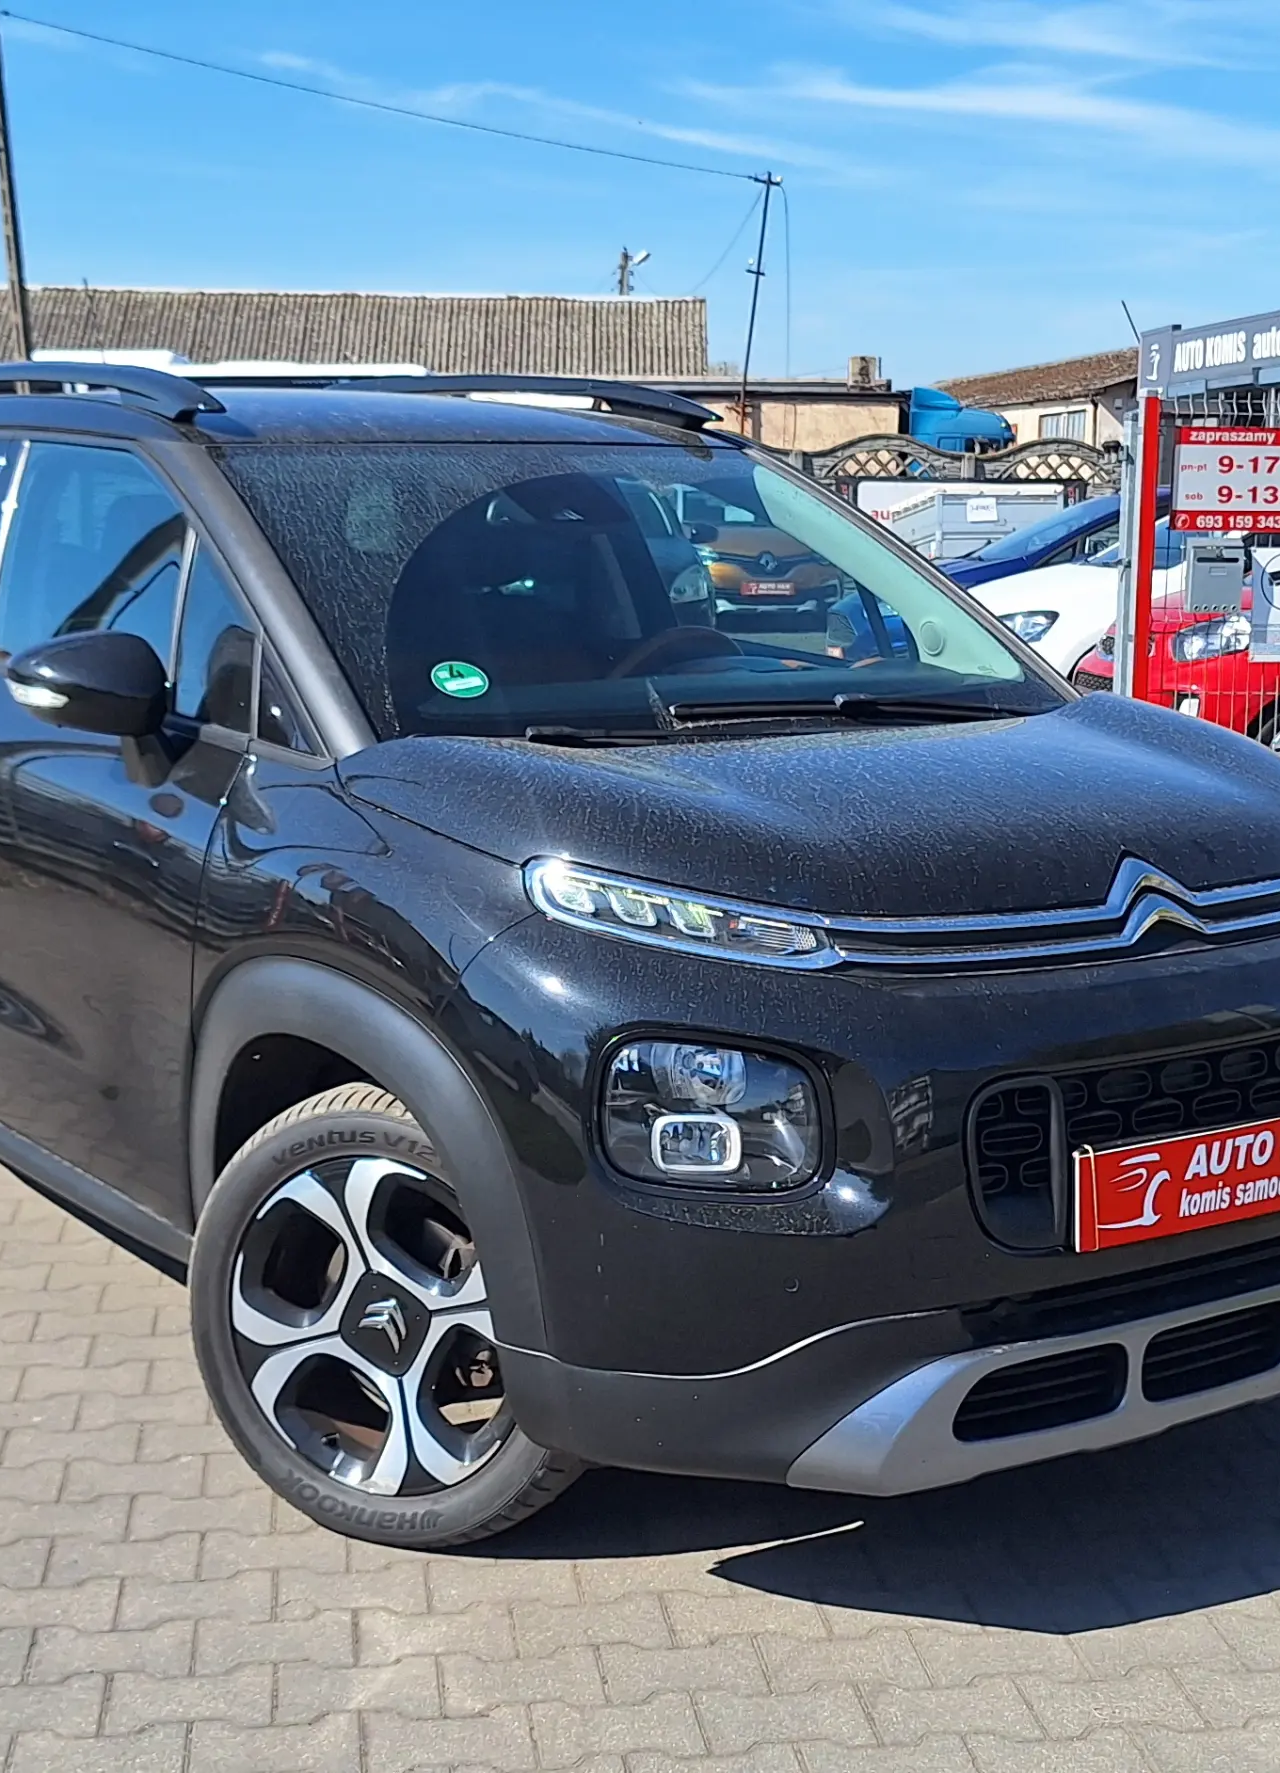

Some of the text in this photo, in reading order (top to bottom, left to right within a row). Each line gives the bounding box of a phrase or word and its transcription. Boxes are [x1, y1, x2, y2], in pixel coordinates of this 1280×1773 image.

[1173, 339, 1204, 373] AUTO
[1205, 331, 1246, 368] KOMIS
[1189, 430, 1277, 444] zapraszamy
[1180, 456, 1280, 474] pn-pt 9-17
[1184, 485, 1280, 504] sob 9-13
[1196, 516, 1223, 529] 693
[1228, 516, 1253, 529] 159
[1184, 1130, 1275, 1181] AUTO
[1178, 1181, 1231, 1218] komis
